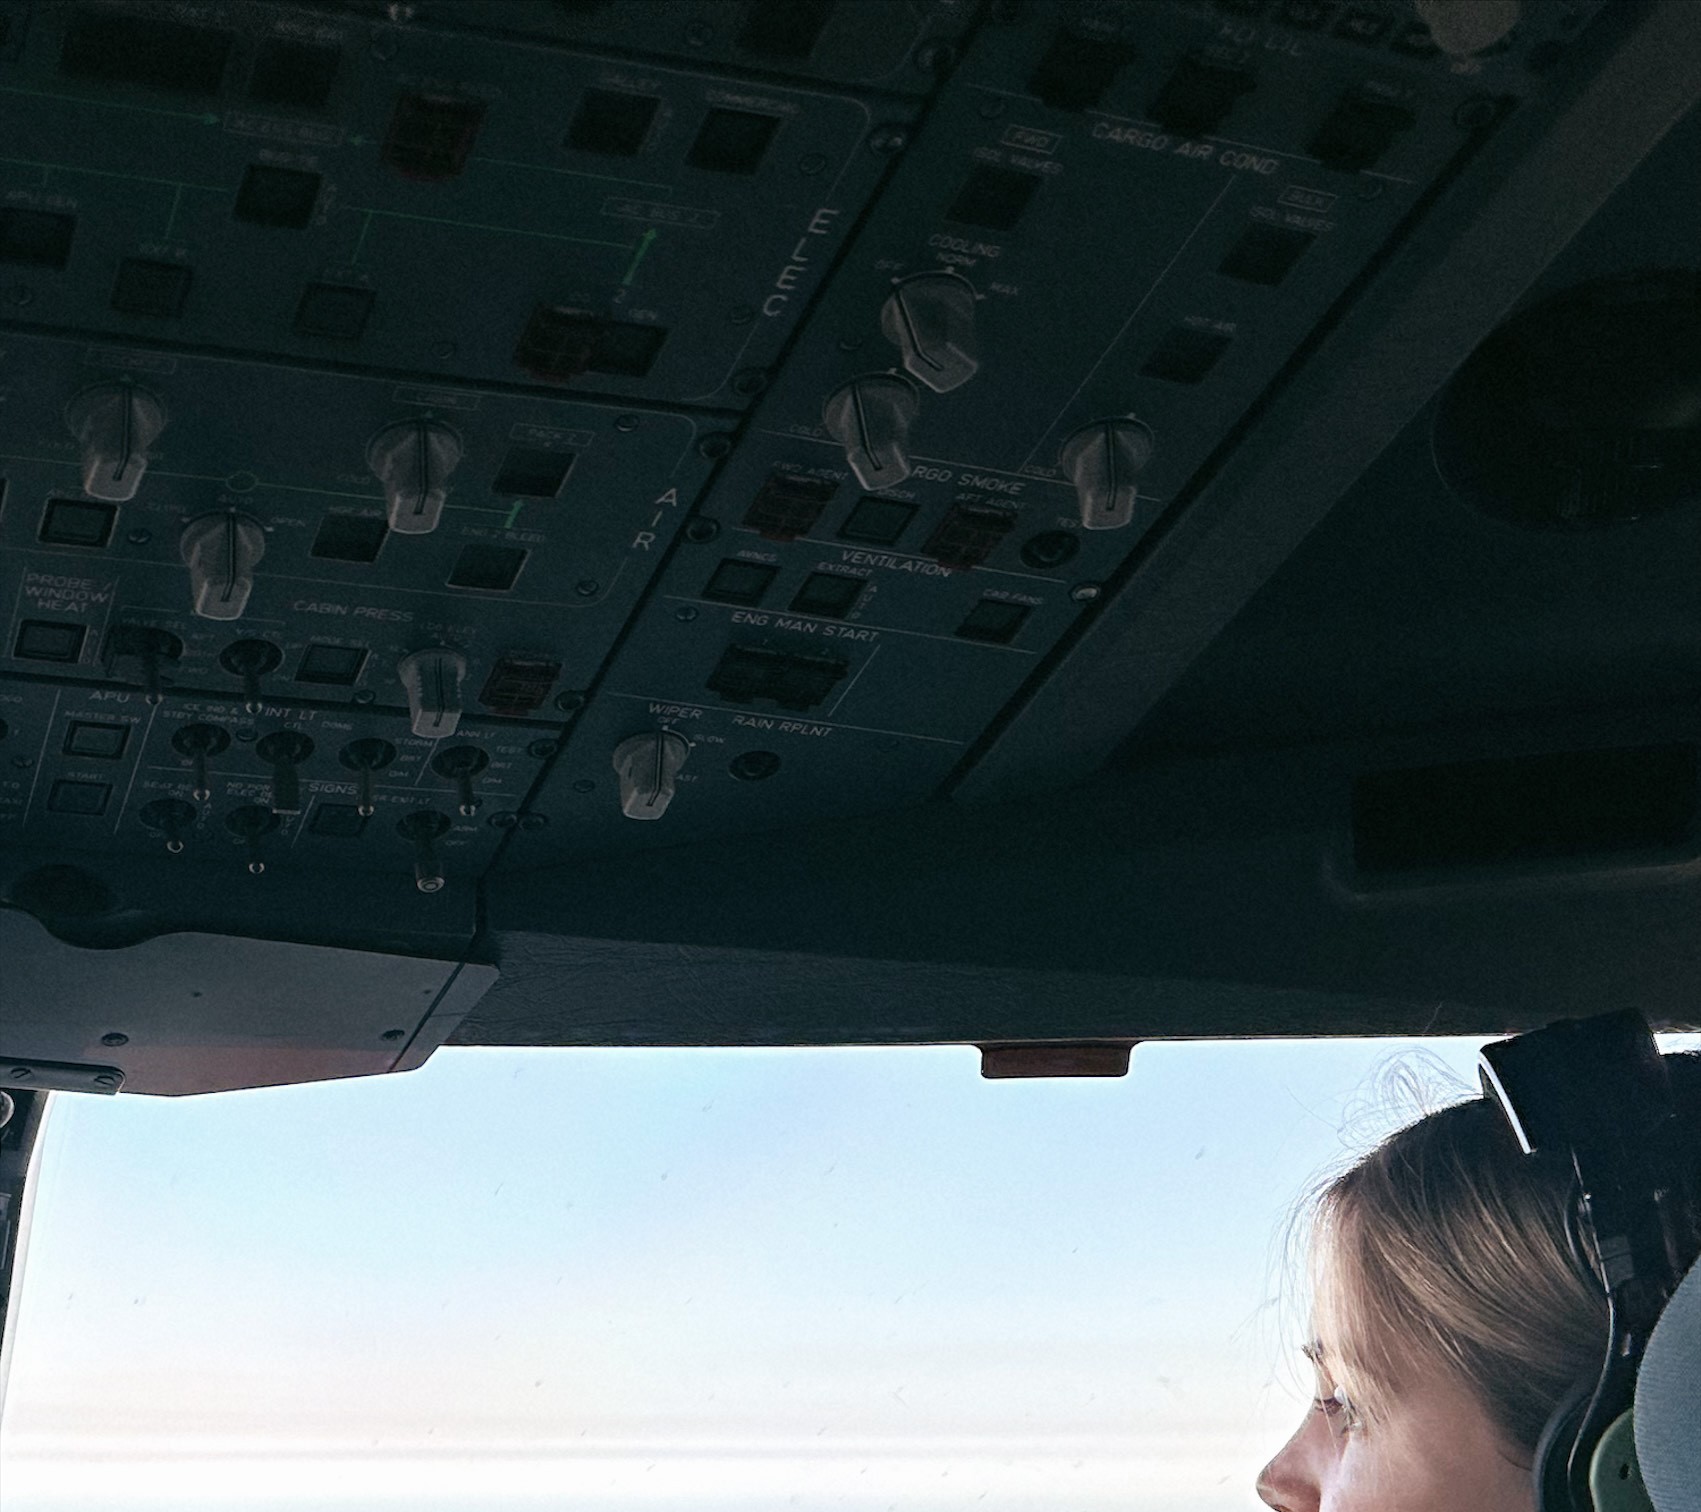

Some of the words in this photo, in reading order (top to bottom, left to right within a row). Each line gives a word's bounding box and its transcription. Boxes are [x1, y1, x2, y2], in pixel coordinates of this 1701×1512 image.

[1092, 121, 1168, 150] CARGO
[1173, 140, 1215, 160] AIR
[1219, 150, 1280, 176] COND
[762, 207, 841, 318] ELEC
[957, 473, 1026, 496] SMOKE
[631, 487, 679, 551] AIR
[817, 561, 874, 577] EXTRACT
[840, 549, 953, 578] VENTILATION
[25, 573, 92, 592] PROBE
[24, 585, 111, 604] WINDOW
[36, 598, 89, 613] HEAT
[293, 600, 348, 616] CABIN
[352, 606, 414, 622] PRESS
[730, 610, 770, 628] ENG
[774, 617, 817, 636] MAN
[821, 623, 881, 643] START
[88, 691, 131, 704] APU
[264, 707, 292, 719] INT
[298, 709, 319, 721] LT
[648, 702, 703, 720] WIPER
[731, 714, 776, 731] RAIN
[778, 720, 833, 738] RPLNT
[308, 782, 359, 796] SIGNS
